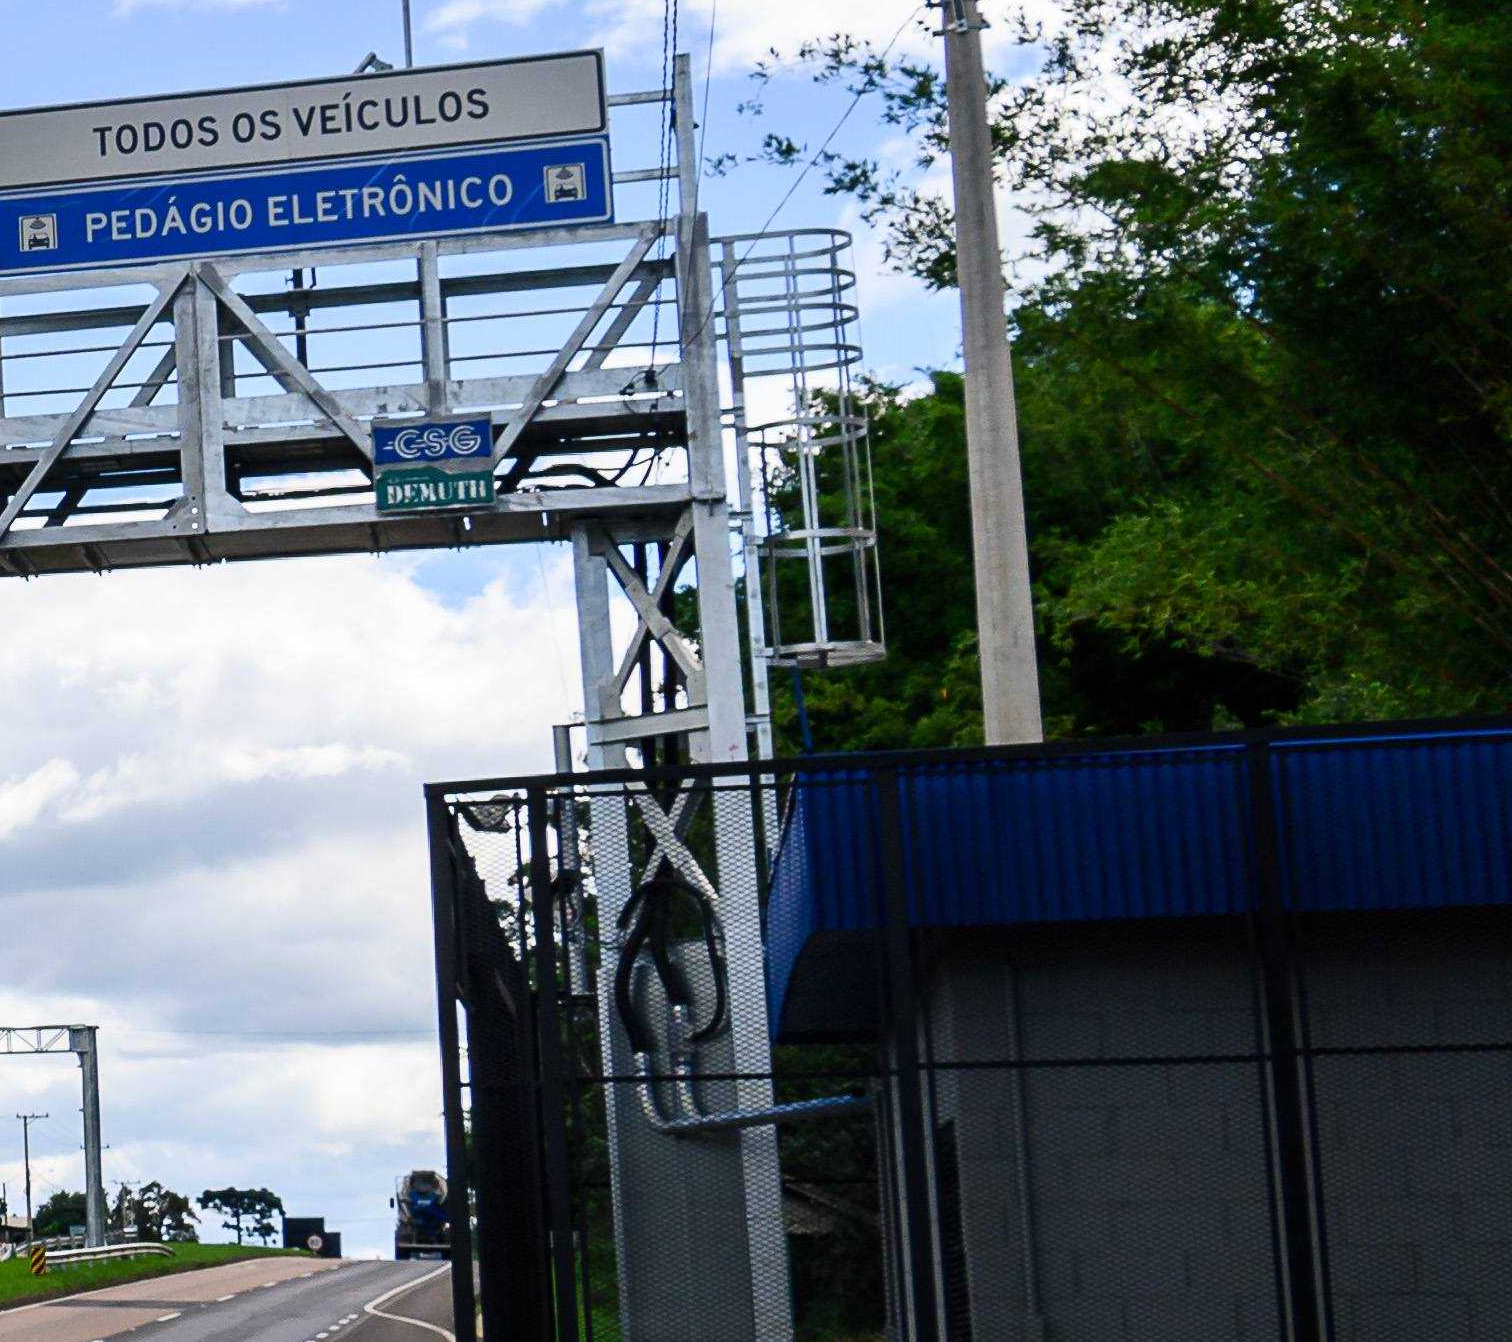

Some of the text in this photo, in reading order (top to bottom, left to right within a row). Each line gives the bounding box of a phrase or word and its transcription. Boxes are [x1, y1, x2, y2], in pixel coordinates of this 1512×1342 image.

[93, 89, 490, 157] TODOS OS VEÍCULOS
[85, 174, 513, 244] PEDÁGIO ELETRÔNICO
[394, 425, 482, 459] CSG
[386, 479, 487, 505] DEMUTH
